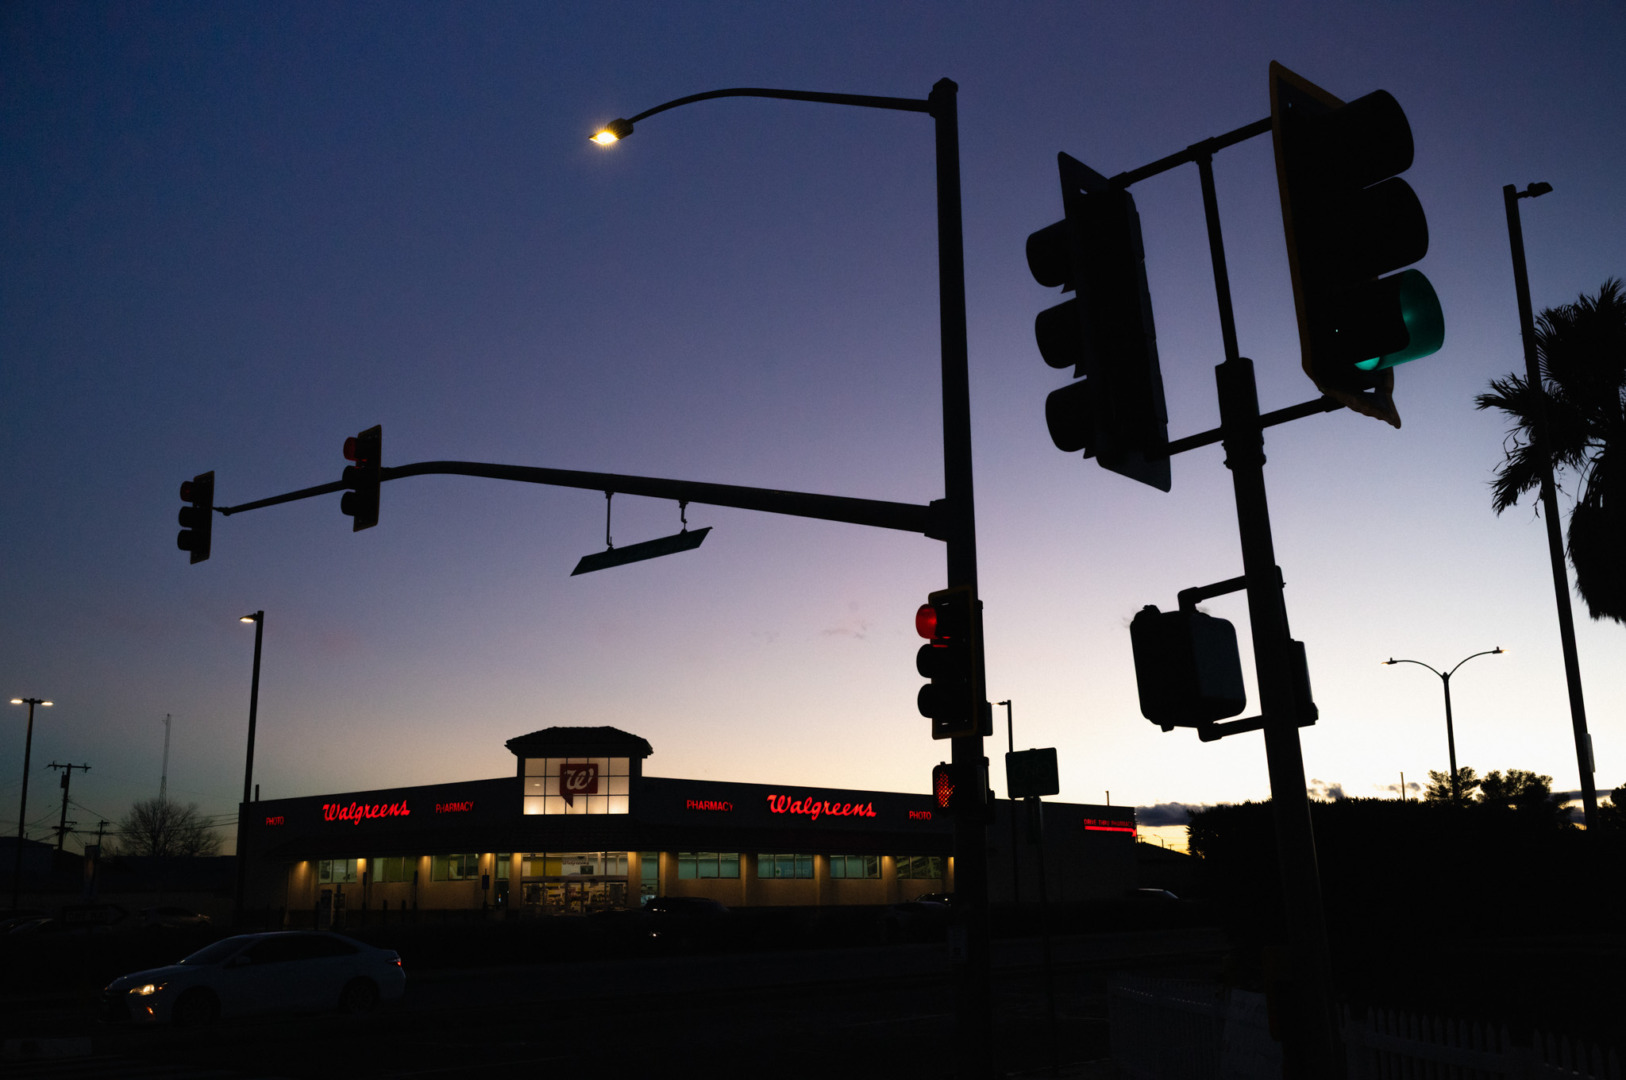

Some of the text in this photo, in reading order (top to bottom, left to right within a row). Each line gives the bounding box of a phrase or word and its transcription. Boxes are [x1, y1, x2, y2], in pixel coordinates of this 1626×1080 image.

[436, 801, 474, 813] PHARMACY
[687, 800, 734, 812] PHARMACY
[766, 794, 877, 821] Walgreens
[322, 800, 411, 825] Walgreens
[909, 810, 932, 820] PHOTO
[266, 816, 284, 826] PHOTO
